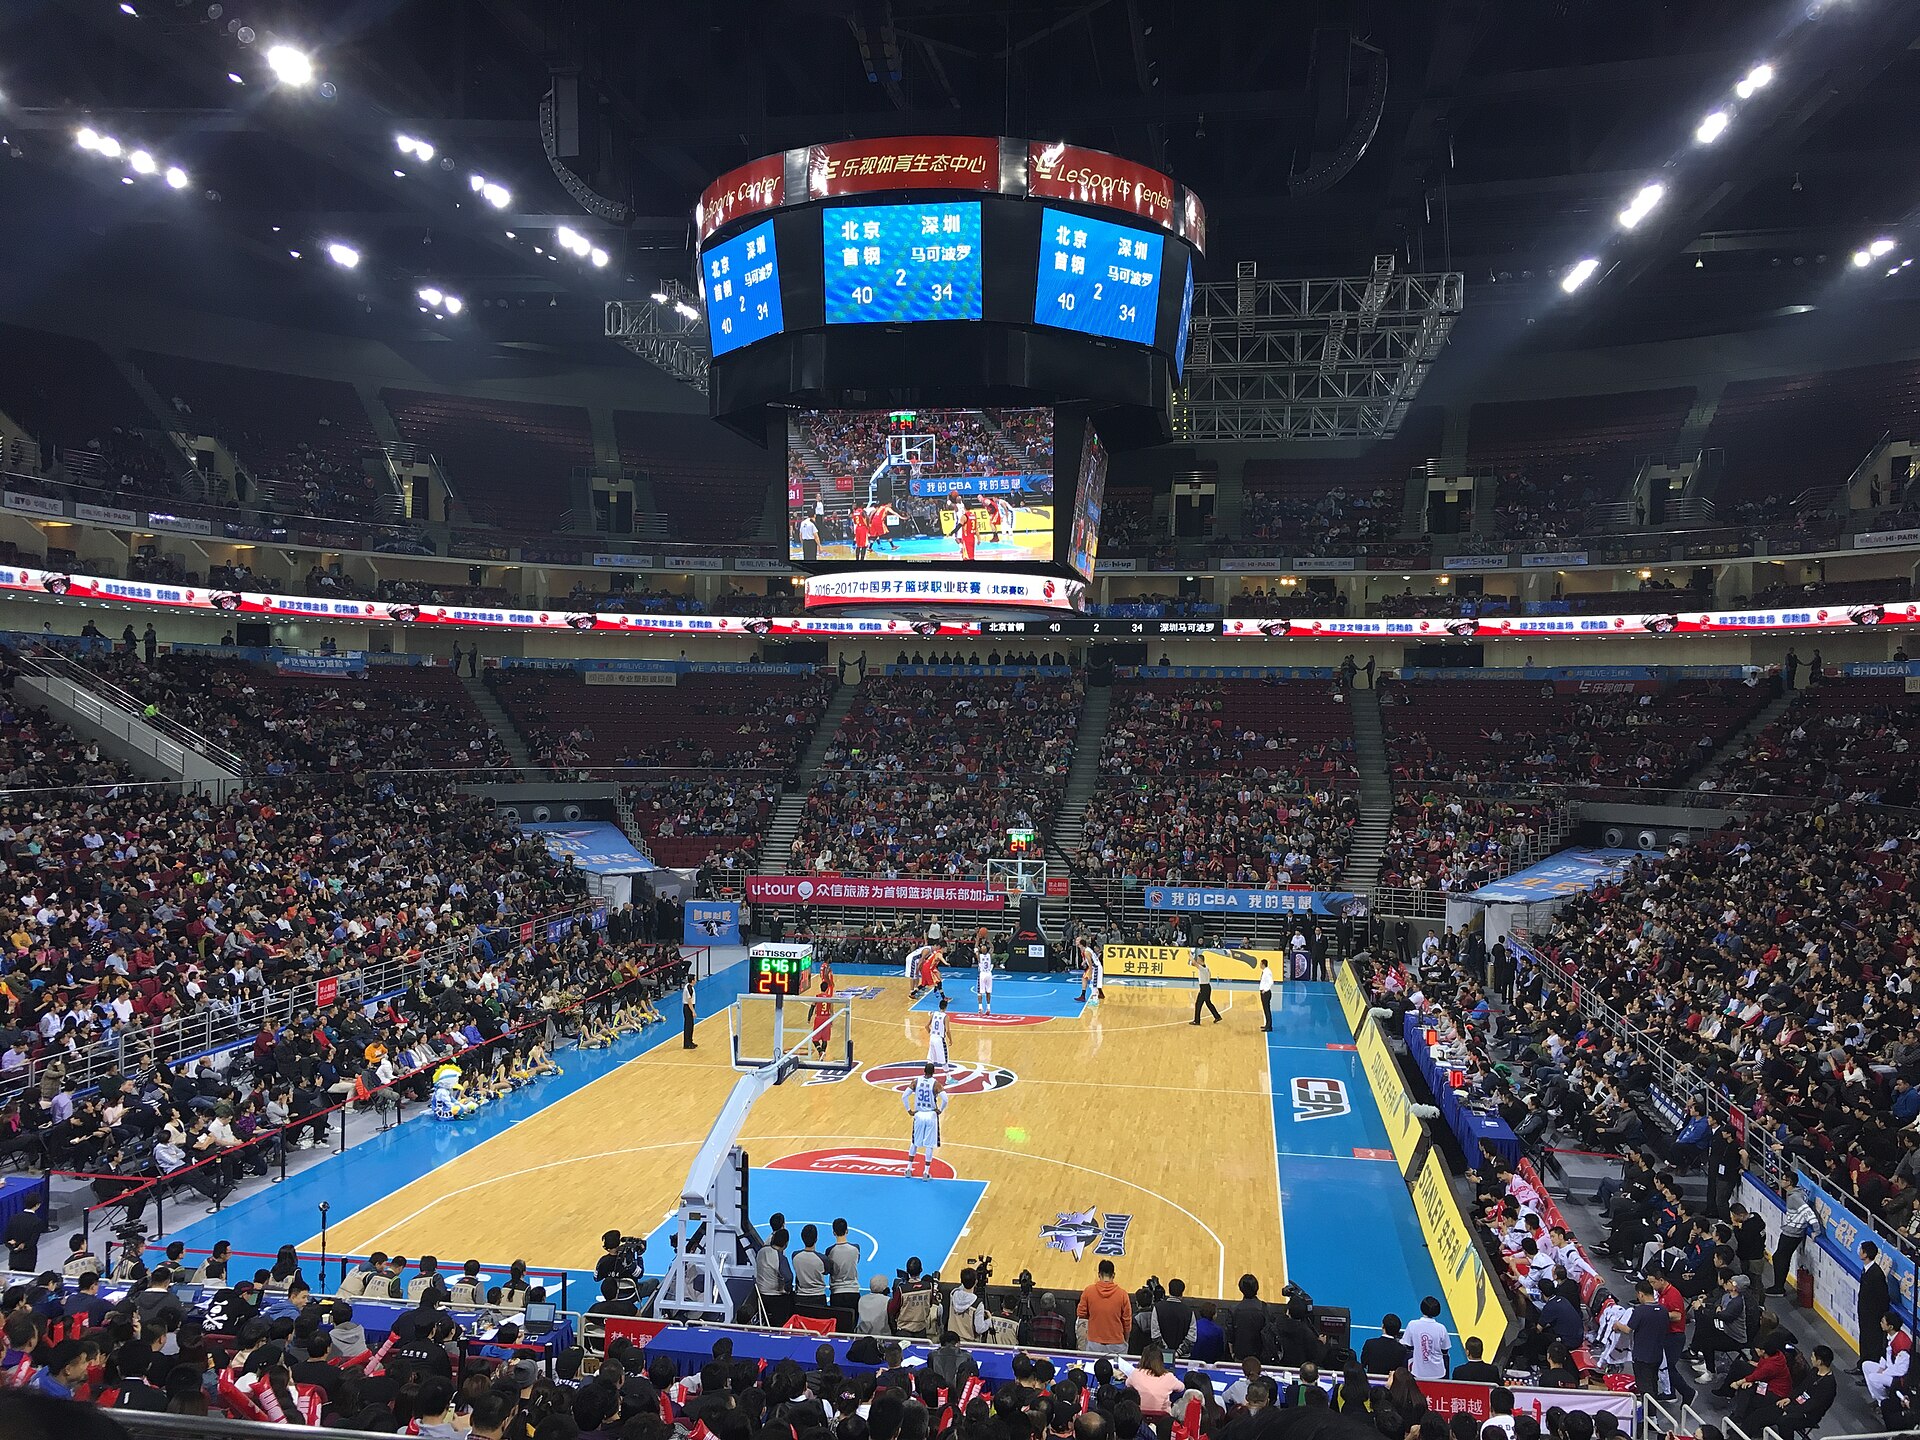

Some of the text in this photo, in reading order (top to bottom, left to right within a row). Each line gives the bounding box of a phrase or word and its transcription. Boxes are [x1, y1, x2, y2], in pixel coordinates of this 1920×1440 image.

[842, 155, 987, 178] 乐视体育生态中心
[738, 176, 781, 202] Center
[1057, 164, 1172, 209] LeSports Center
[842, 214, 960, 240] 北京 深圳
[1056, 225, 1149, 261] 北京 深圳
[712, 235, 766, 279] 北京 深圳
[842, 245, 971, 266] 首钢 马可波罗
[896, 268, 906, 287] 2
[1055, 251, 1153, 287] 首钢 马可波罗
[714, 262, 773, 302] 首钢 马可波罗
[1093, 283, 1103, 301] 2
[852, 284, 952, 304] 40 34
[739, 296, 746, 313] 2
[1058, 292, 1136, 323] 40 34
[722, 302, 769, 334] 40 34
[900, 420, 914, 430] 24
[927, 481, 972, 493] 我的CBA
[988, 622, 1215, 632] 北京首钢 40 2 34 深圳马可波罗
[689, 664, 705, 673] WE
[710, 665, 732, 673] ARE
[1592, 683, 1635, 693] 乐视体育
[1010, 840, 1026, 851] 24
[751, 882, 796, 896] u-tour
[816, 883, 870, 899] 众信旅游
[1171, 891, 1313, 910] 我的CBA 我的梦想
[765, 950, 798, 958] TISSOT
[1107, 946, 1180, 963] STANLEY
[1123, 963, 1164, 978] 史丹利
[759, 971, 789, 992] 24
[822, 1002, 828, 1011] 3
[917, 1089, 931, 1103] 32
[1293, 1078, 1347, 1120] CBA
[1417, 1164, 1446, 1234] STANLEY
[1093, 1213, 1134, 1258] DUCKS
[1437, 1217, 1462, 1275] 史丹利
